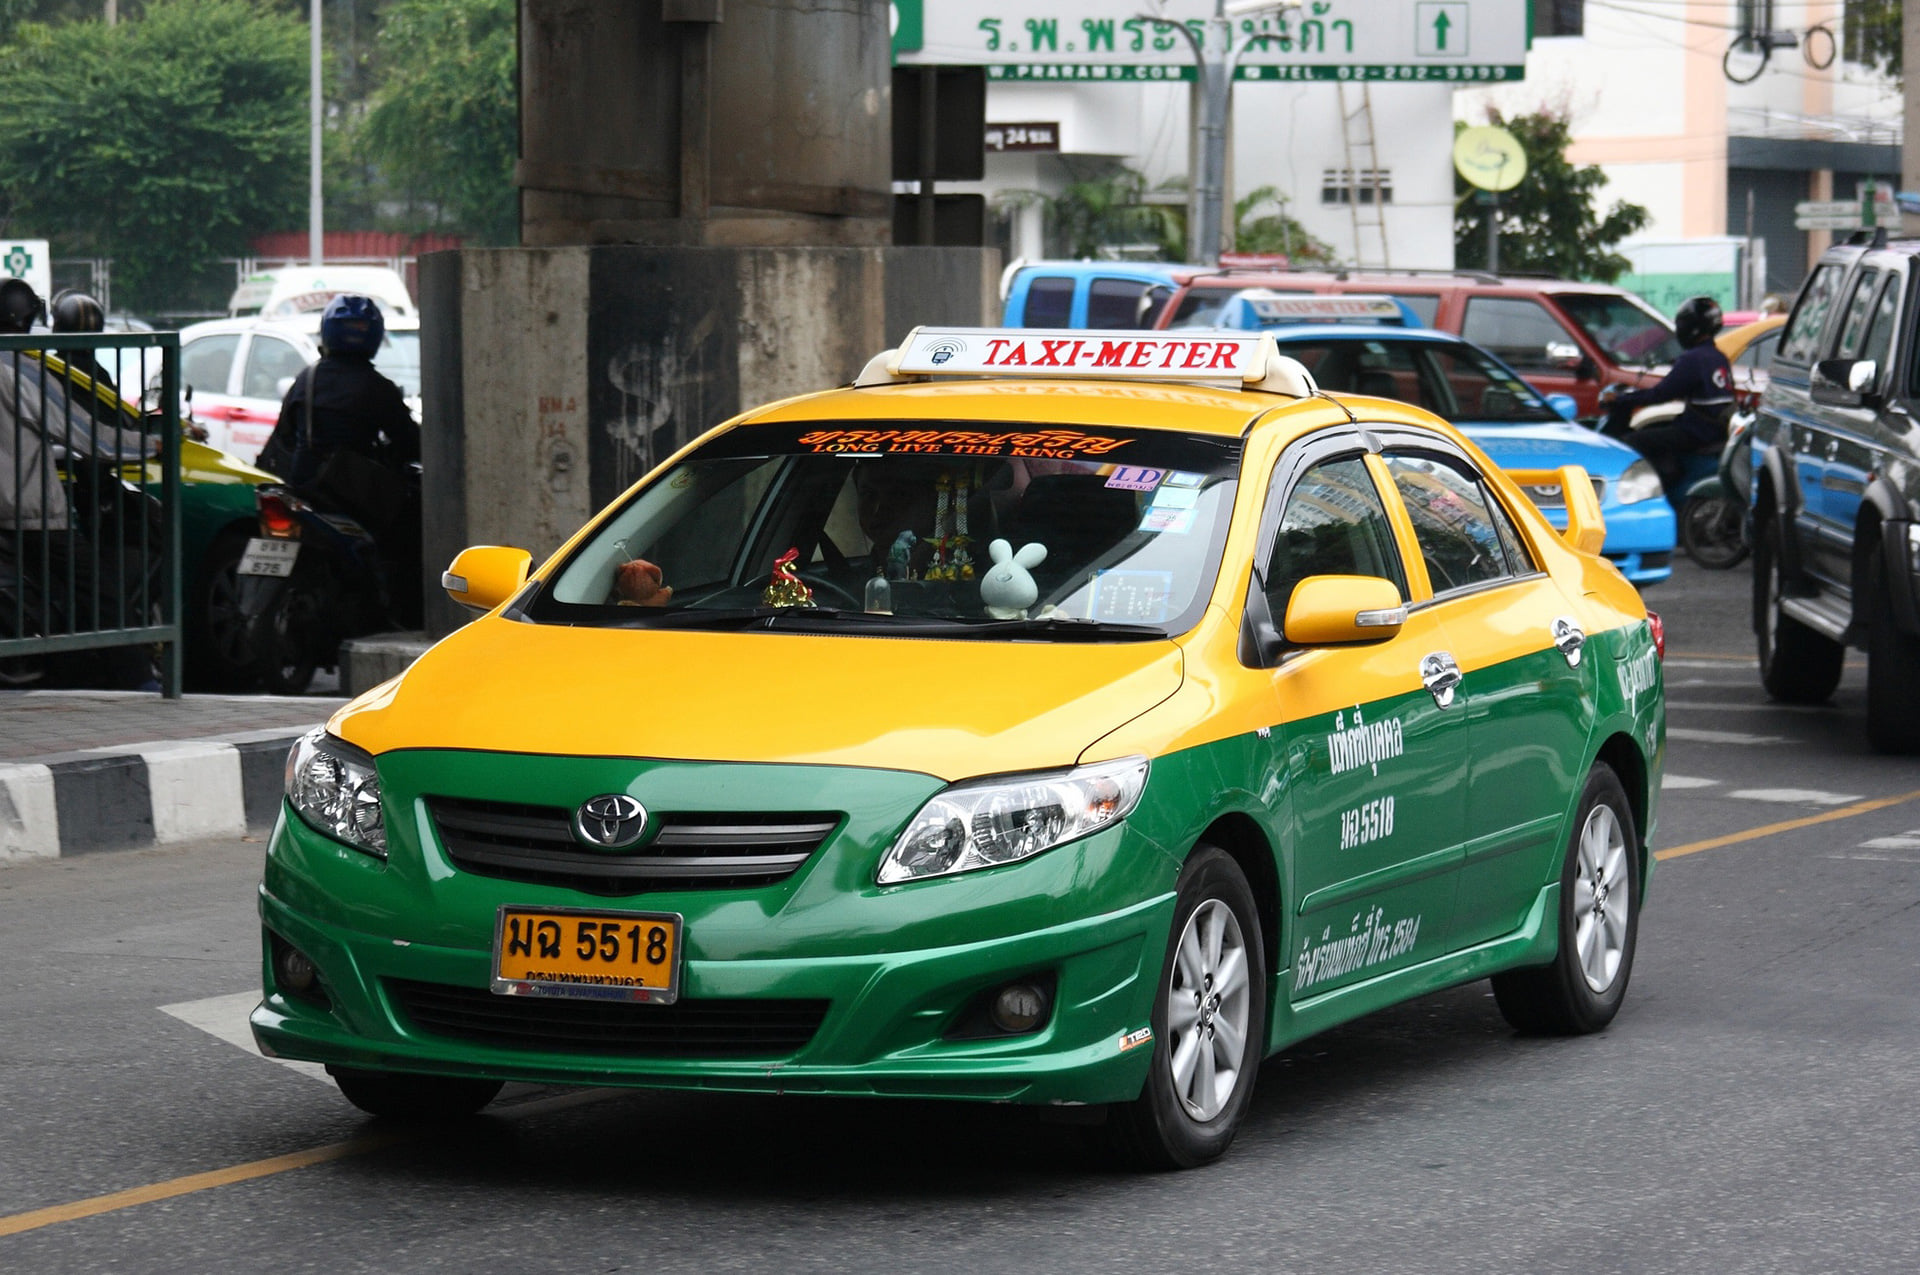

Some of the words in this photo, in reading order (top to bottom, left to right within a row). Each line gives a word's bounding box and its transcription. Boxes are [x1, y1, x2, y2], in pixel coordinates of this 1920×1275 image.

[1278, 67, 1324, 80] TEL.
[1337, 67, 1507, 80] 02-202-9999
[983, 340, 1240, 369] TAXI-METER
[811, 443, 879, 453] LONG
[888, 443, 941, 453] LIVE
[952, 444, 1001, 455] THE
[1010, 447, 1075, 459] KING
[1113, 466, 1161, 483] LD
[1328, 703, 1403, 777] แท็กซี่บุคคล
[1360, 795, 1395, 844] 5518
[509, 917, 561, 959] มฉ
[576, 921, 667, 965] 5518
[526, 970, 645, 987] กรงเทพมหานคร
